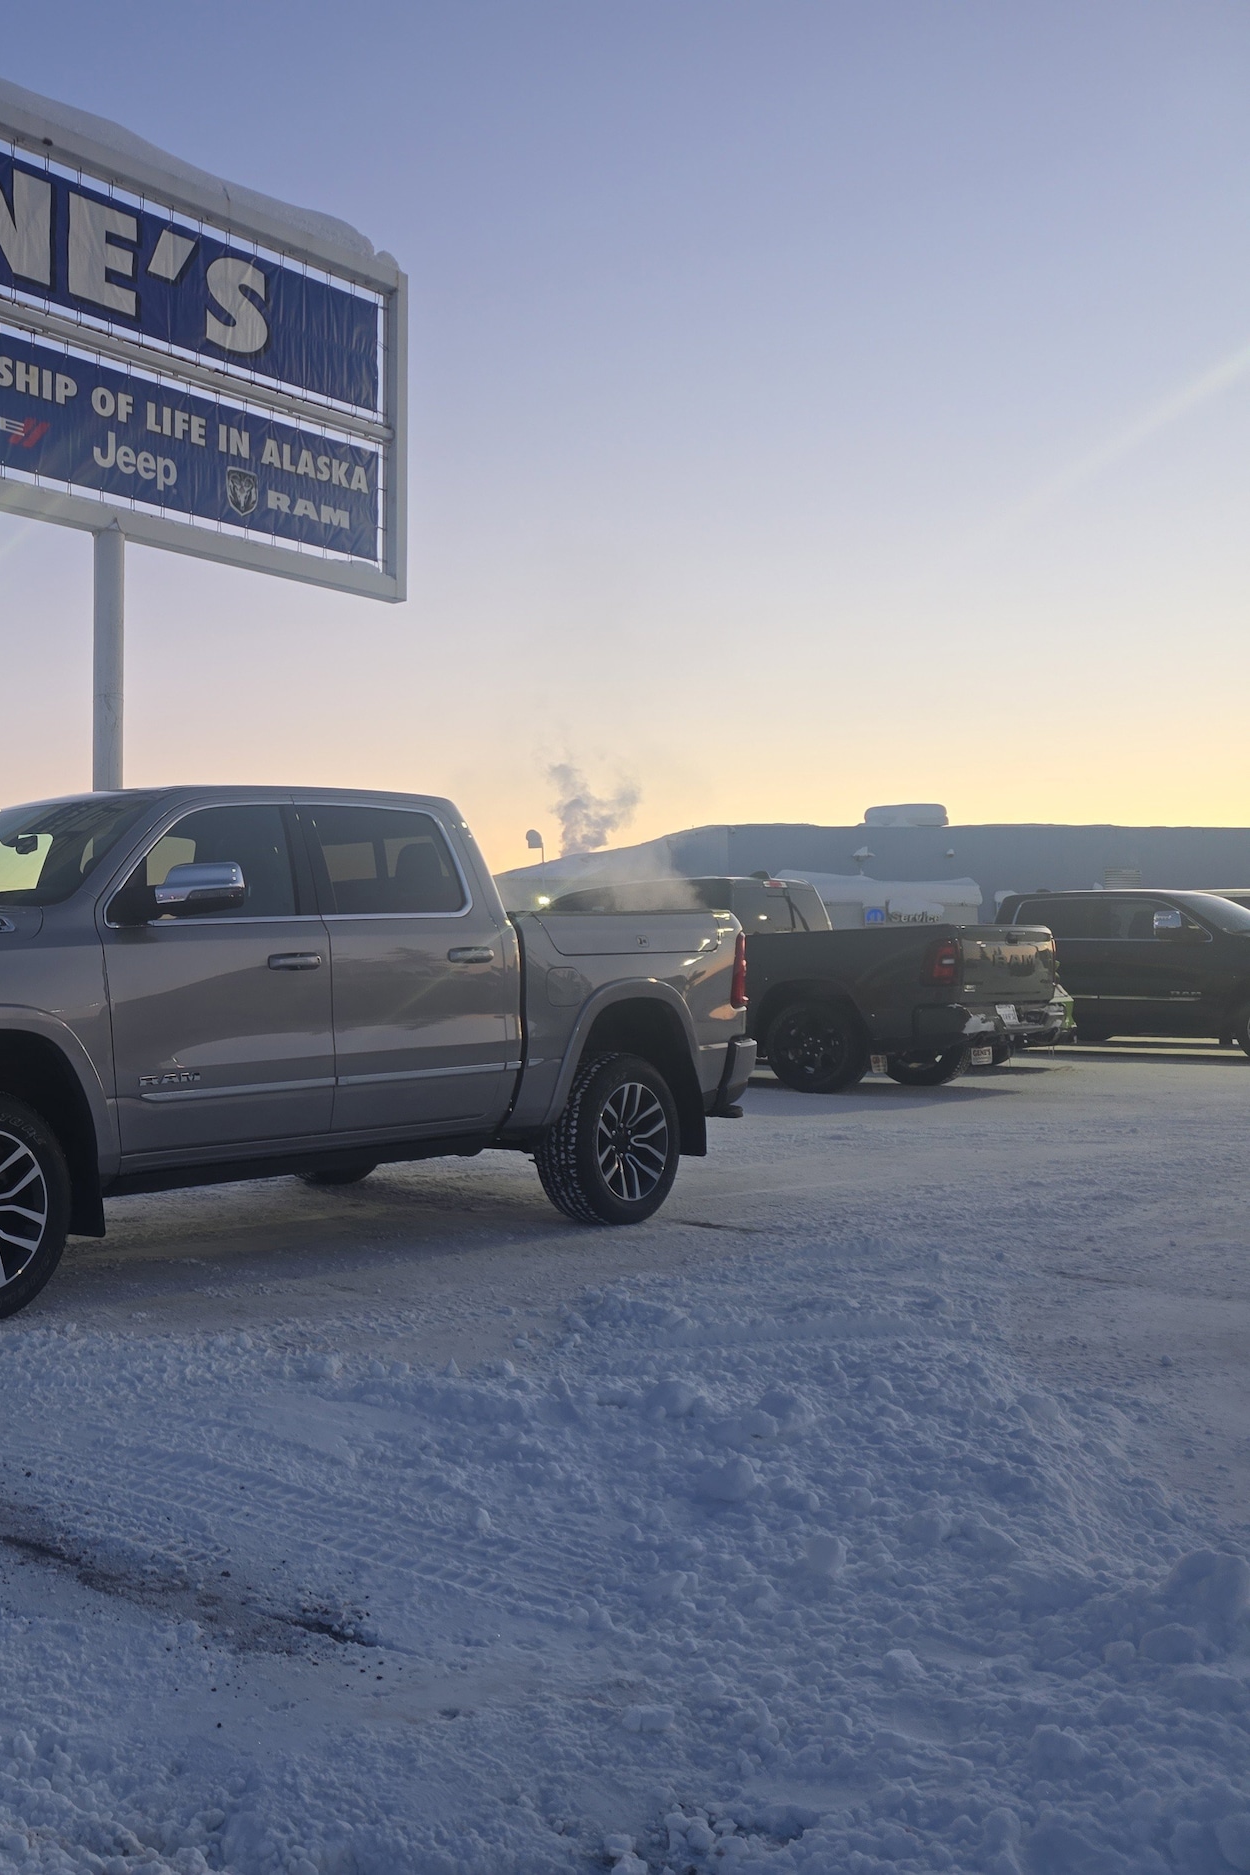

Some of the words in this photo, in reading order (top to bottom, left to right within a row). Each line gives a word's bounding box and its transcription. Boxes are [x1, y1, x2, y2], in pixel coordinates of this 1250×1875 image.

[91, 386, 134, 424] OF
[146, 402, 207, 449] LIFE
[218, 423, 250, 460] IN
[261, 439, 370, 496] ALASKA
[93, 432, 178, 491] Jeep
[267, 489, 350, 530] RAM
[891, 911, 941, 923] Service
[139, 1073, 201, 1087] RAM
